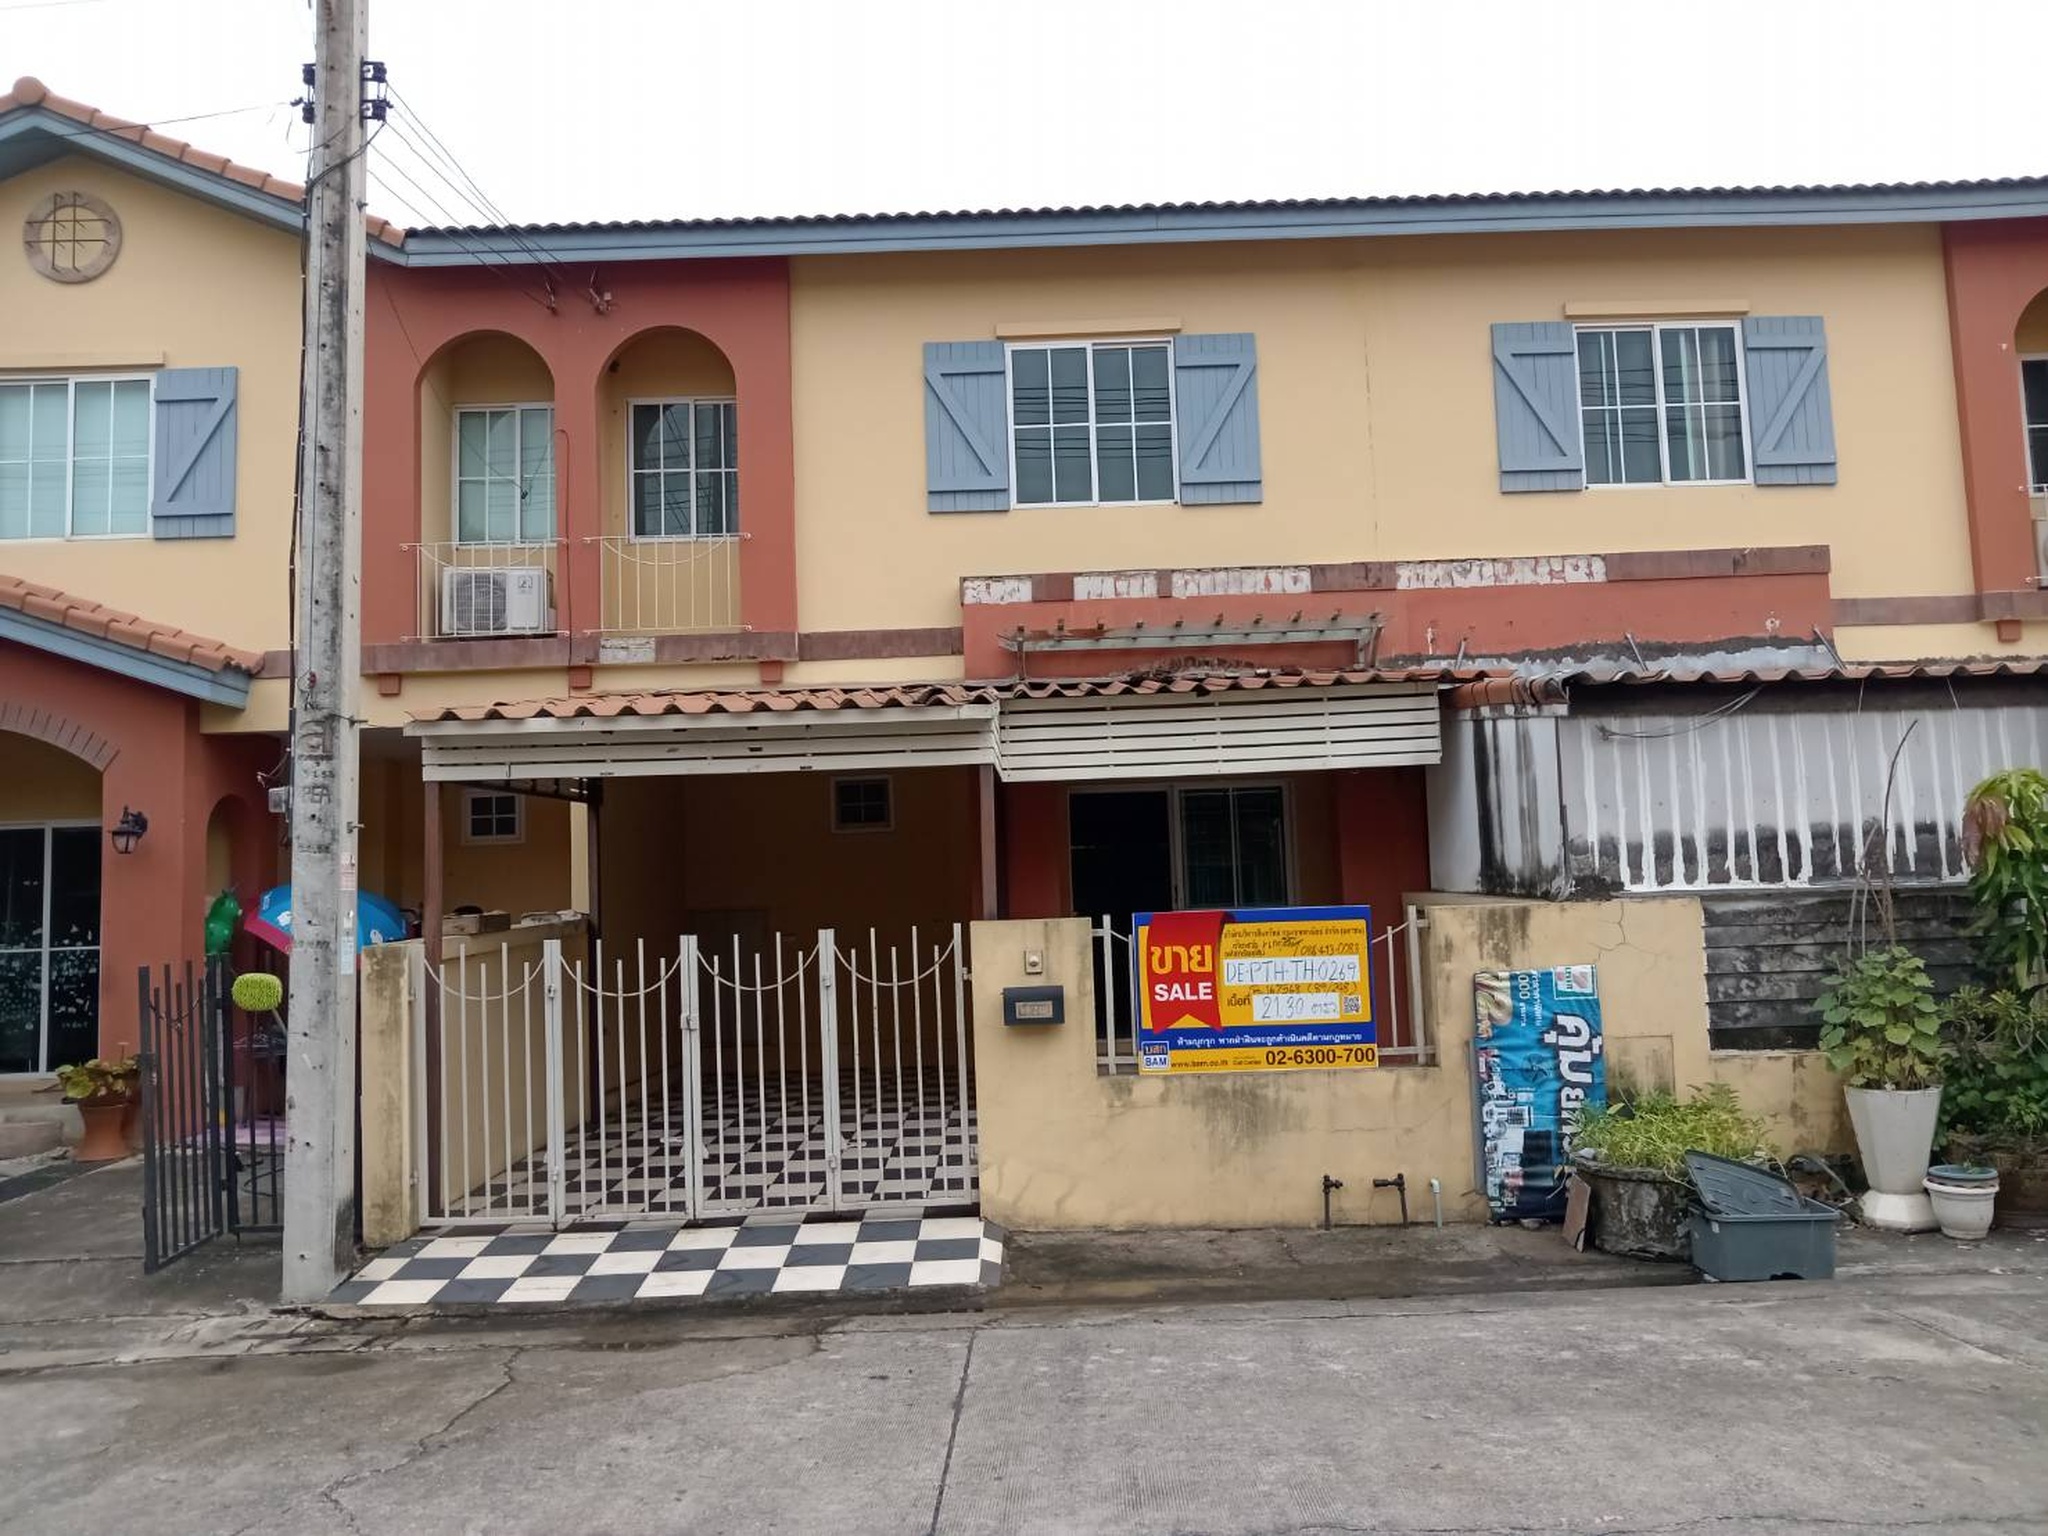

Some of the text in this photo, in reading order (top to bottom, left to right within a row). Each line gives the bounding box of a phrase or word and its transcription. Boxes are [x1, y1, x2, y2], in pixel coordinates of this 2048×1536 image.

[1150, 945, 1213, 975] ขาย
[1154, 982, 1213, 1002] SALE
[1145, 1057, 1167, 1067] BAM
[1265, 1047, 1376, 1066] 02-6300-700
